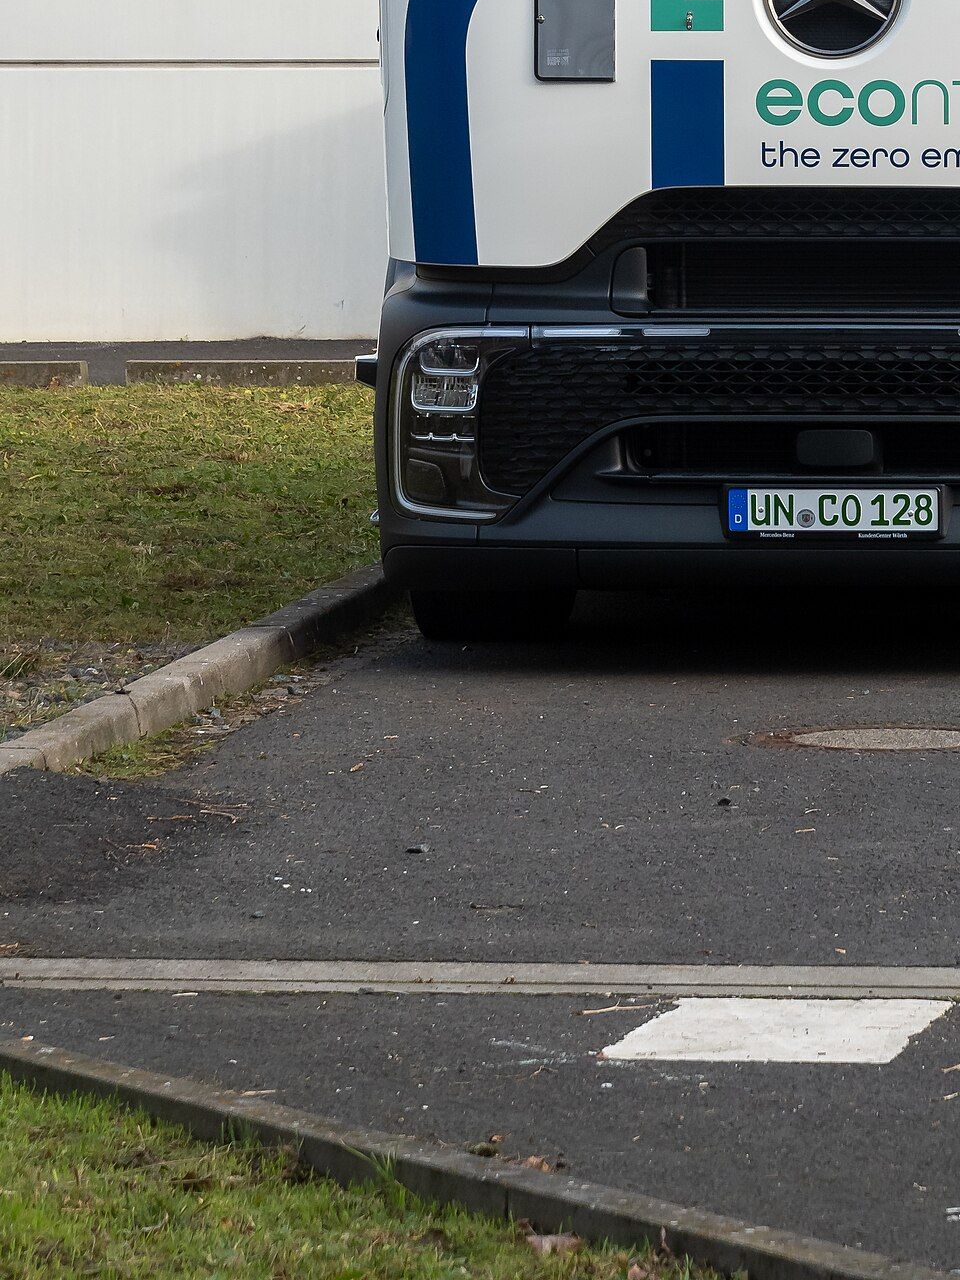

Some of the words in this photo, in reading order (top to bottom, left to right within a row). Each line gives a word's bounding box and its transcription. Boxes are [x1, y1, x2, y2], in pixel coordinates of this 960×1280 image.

[761, 140, 821, 168] the
[831, 146, 910, 168] zero
[734, 514, 743, 524] D
[750, 493, 794, 526] UN
[818, 493, 861, 526] CO
[870, 493, 934, 526] 128
